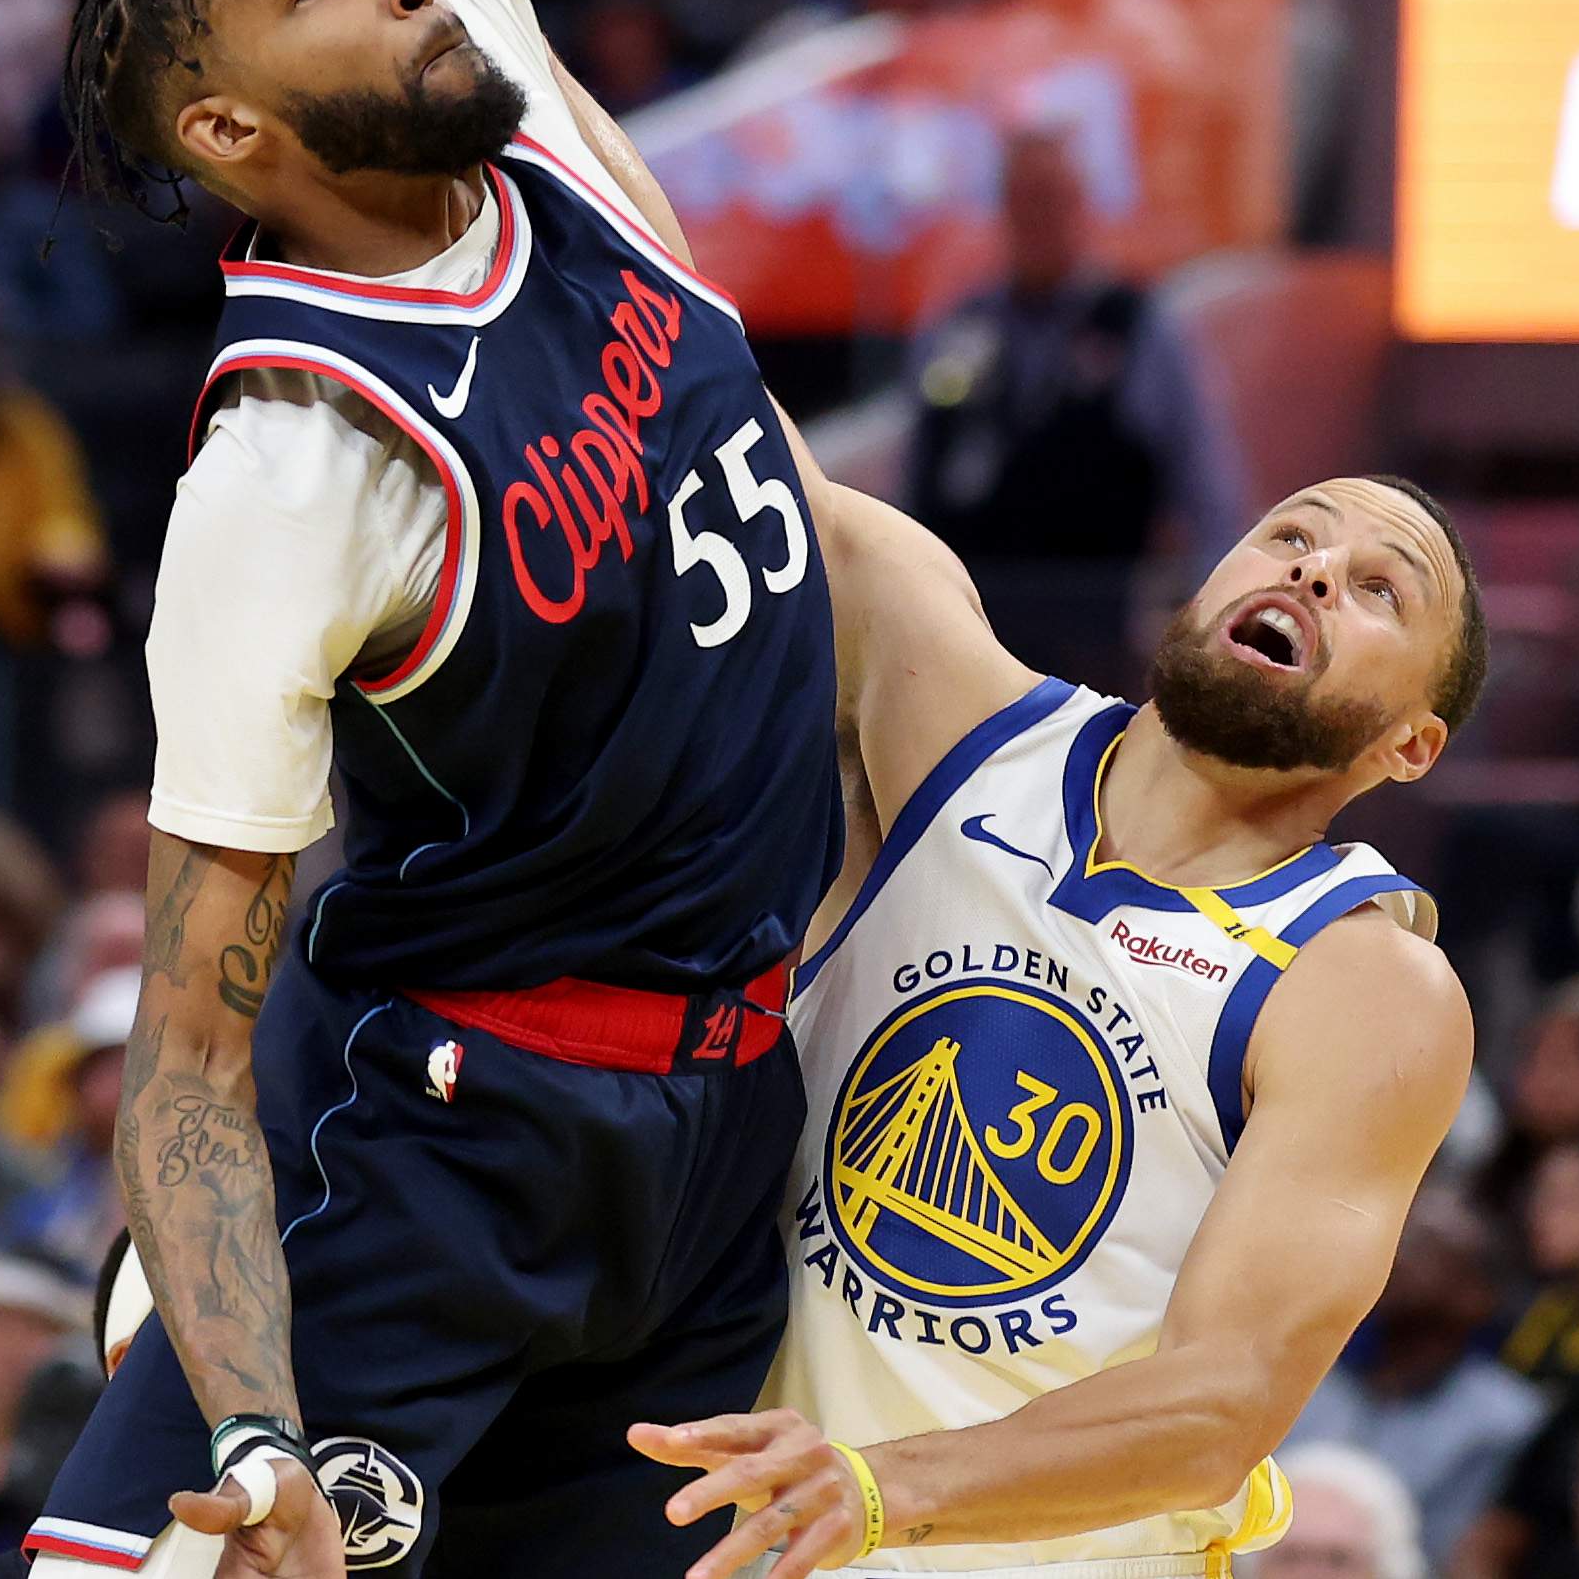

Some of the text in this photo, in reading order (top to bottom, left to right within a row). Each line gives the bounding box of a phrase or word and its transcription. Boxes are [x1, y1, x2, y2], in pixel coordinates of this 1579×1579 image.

[502, 269, 683, 624] Clippers
[667, 417, 810, 649] 55
[893, 945, 1167, 1113] GOLDEN STATE
[1110, 920, 1229, 984] Rakuten
[984, 1069, 1103, 1186] 30
[795, 1175, 1077, 1355] WARRIORS
